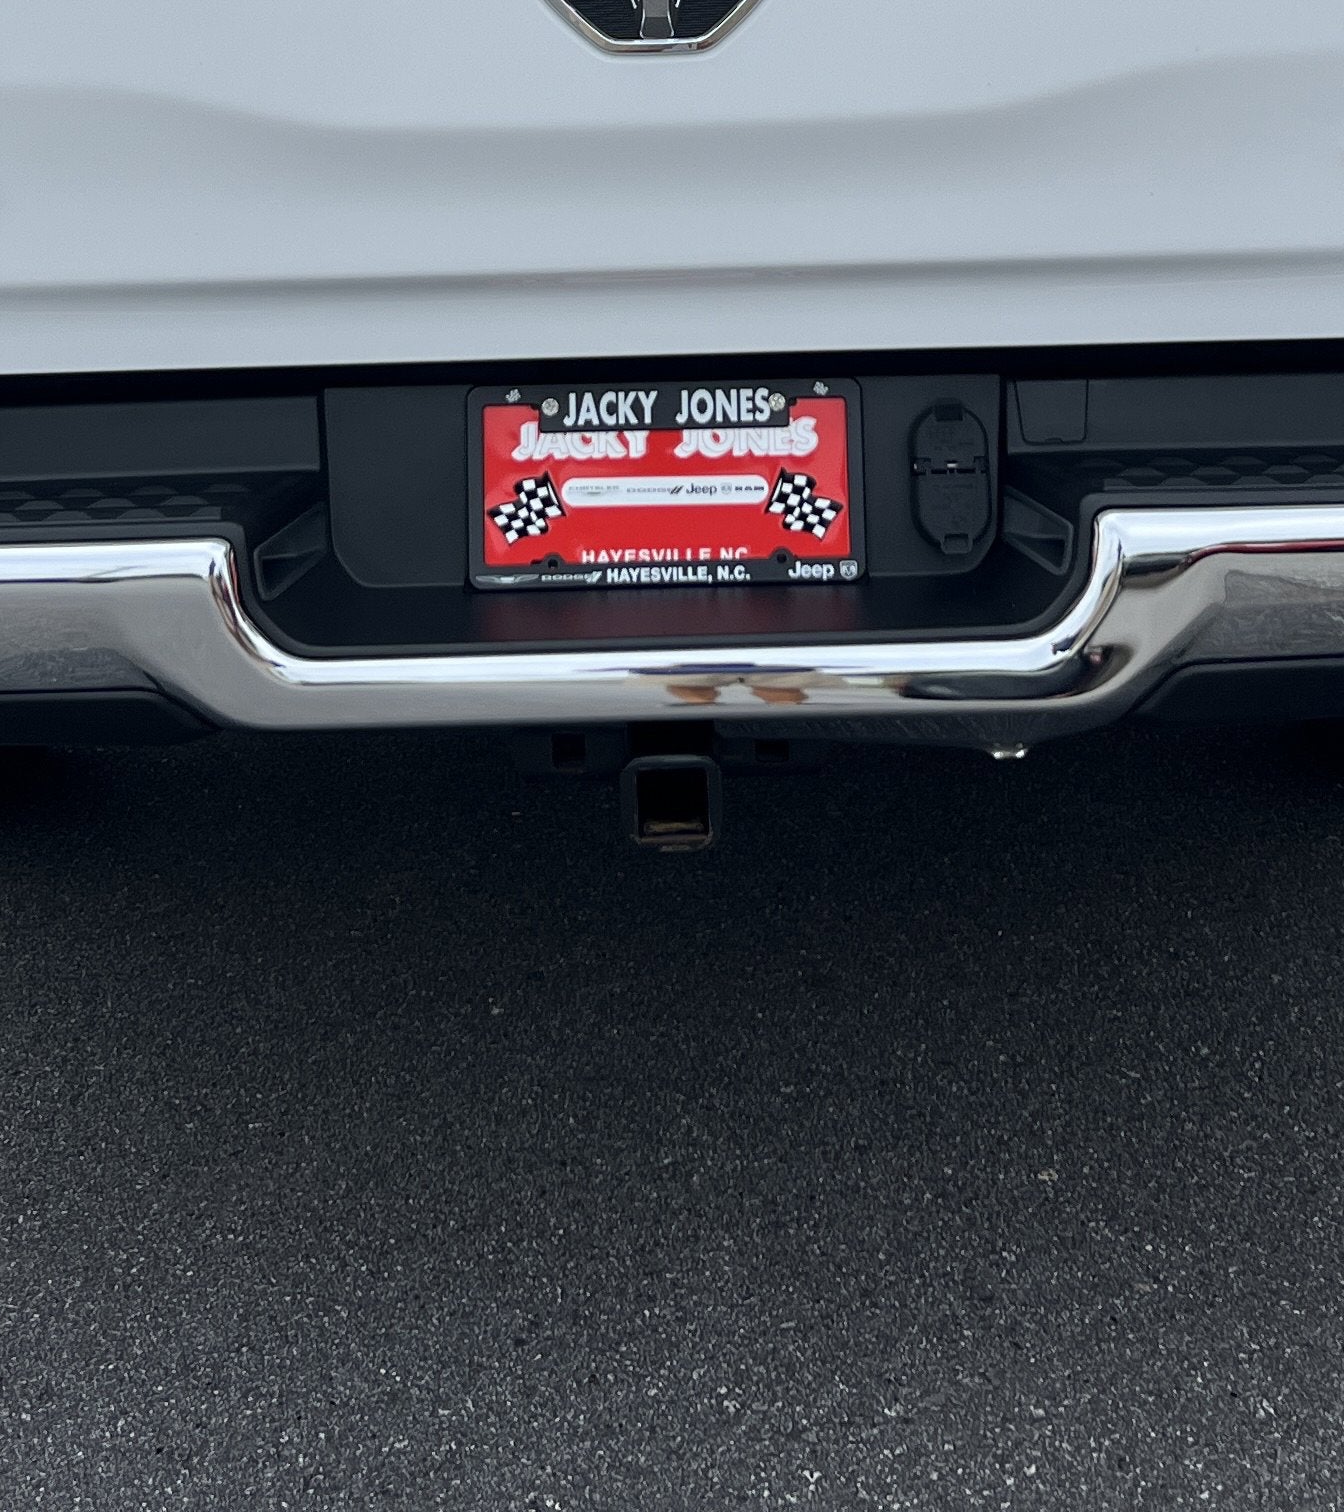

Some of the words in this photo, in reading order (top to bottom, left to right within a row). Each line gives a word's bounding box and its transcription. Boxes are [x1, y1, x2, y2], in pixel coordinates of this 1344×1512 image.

[563, 390, 657, 426] JACKY
[675, 387, 771, 425] JONES
[511, 421, 652, 463] JACKY
[673, 416, 819, 459] JONES
[686, 483, 718, 496] Jeep
[606, 565, 713, 584] HAYESVILLE,
[717, 564, 751, 581] N.C.
[788, 560, 835, 581] Jeep
